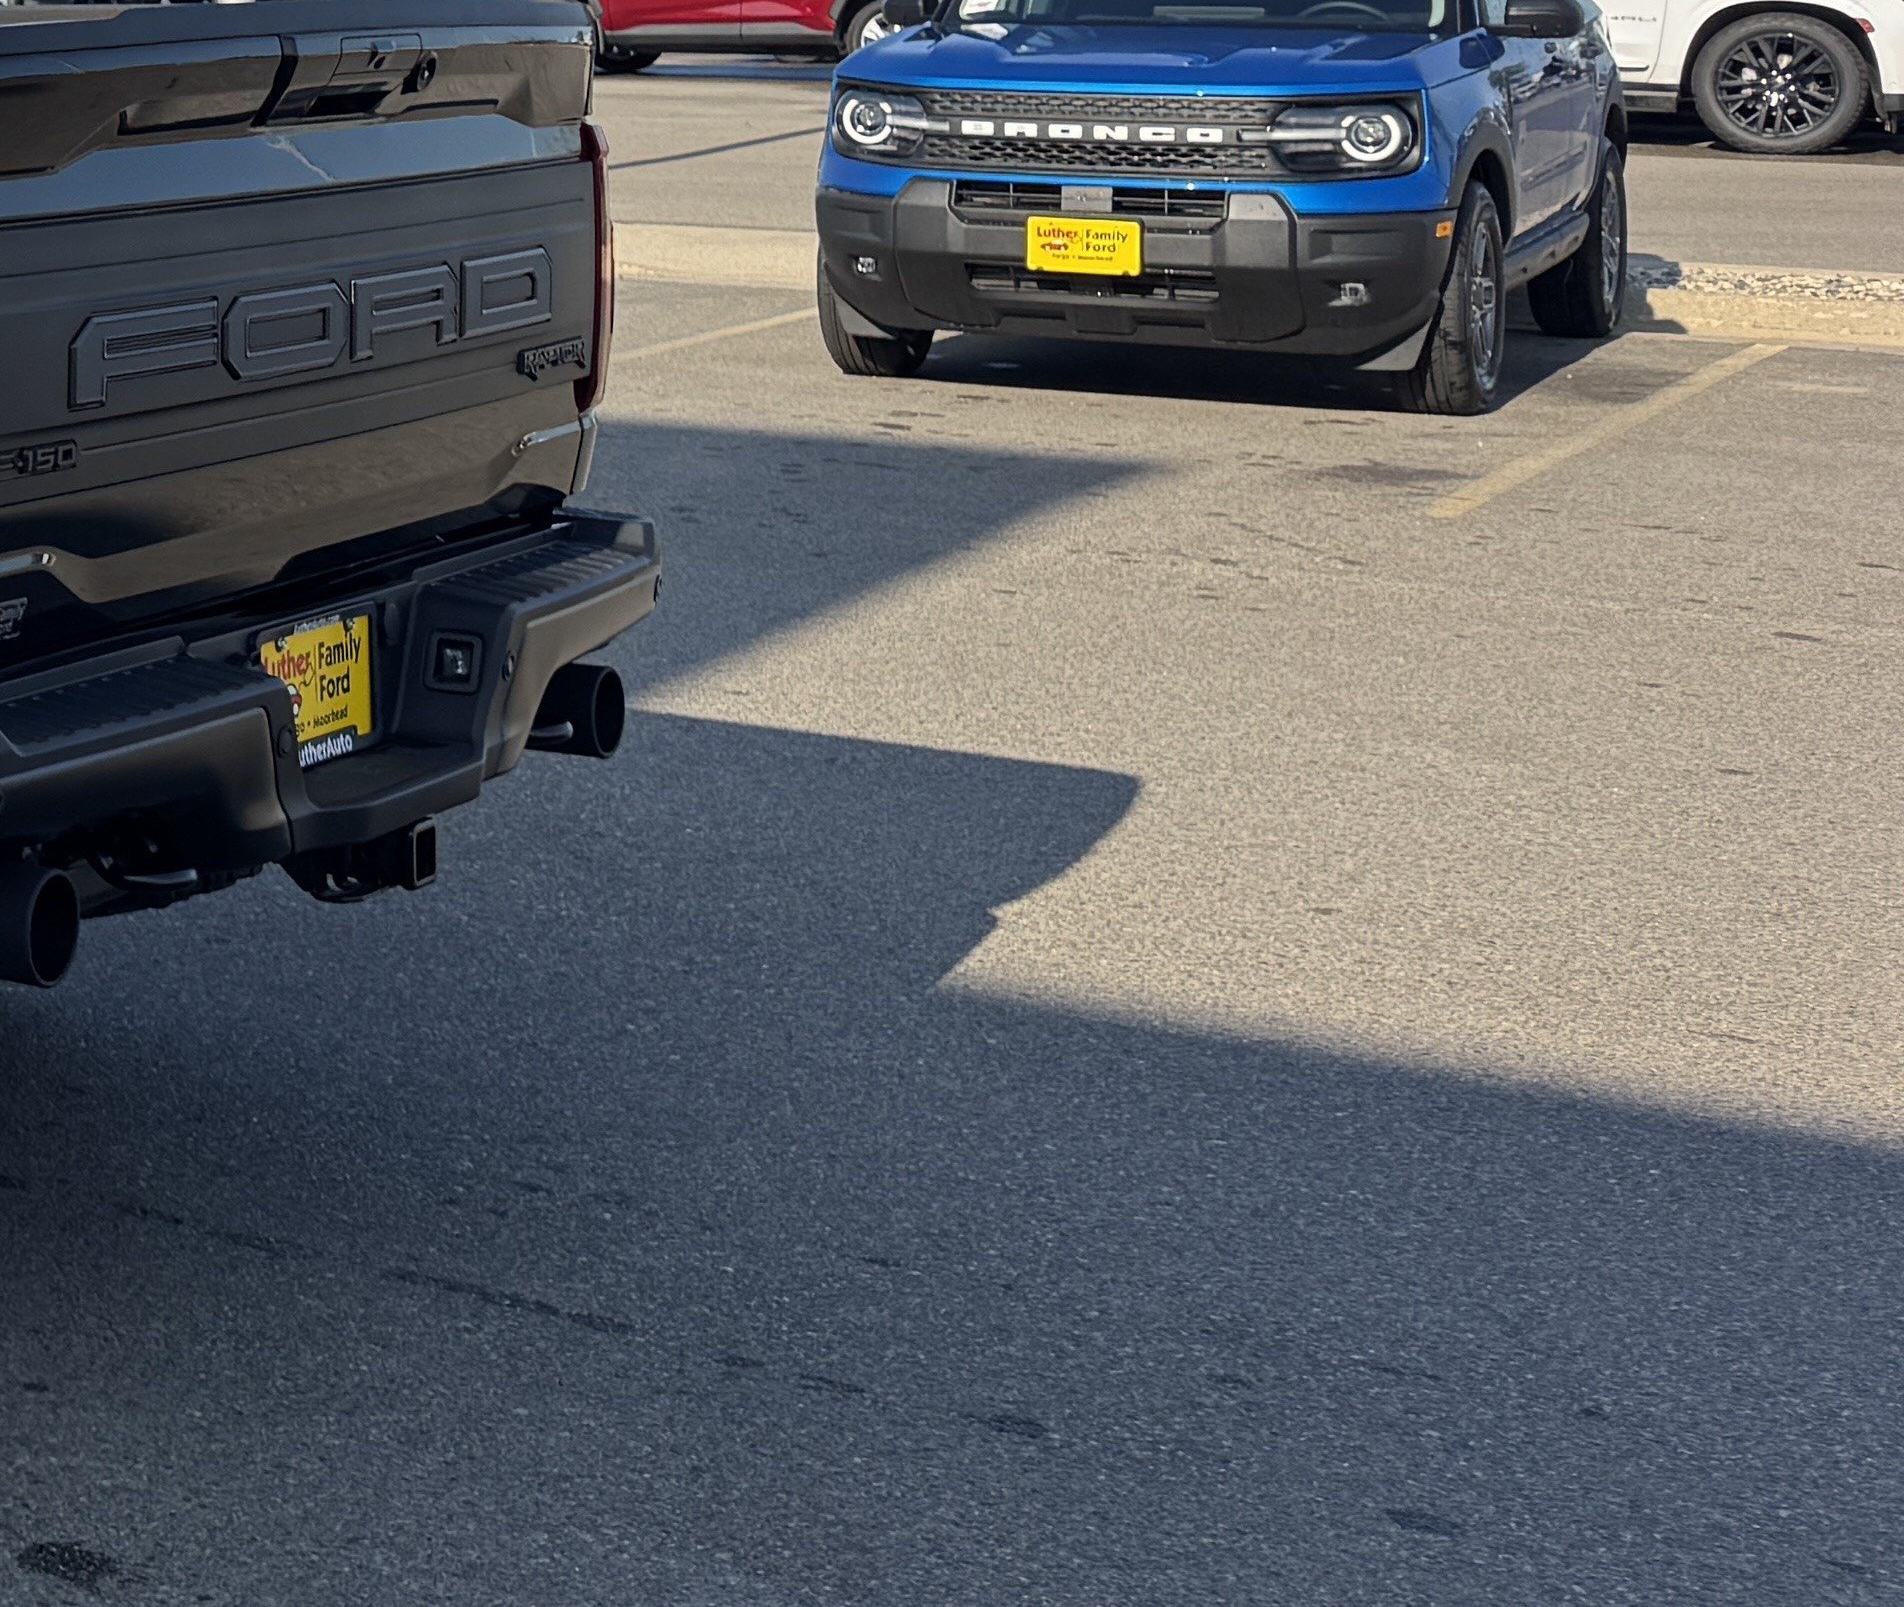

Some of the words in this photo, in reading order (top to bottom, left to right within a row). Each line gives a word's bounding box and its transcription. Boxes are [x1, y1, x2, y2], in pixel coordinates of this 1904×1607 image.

[960, 119, 1224, 143] BRONCO
[1036, 226, 1079, 238] Luther
[1085, 228, 1129, 243] Family
[1085, 242, 1117, 253] Ford
[67, 244, 553, 411] FORD
[318, 632, 362, 670] Family
[319, 665, 351, 703] Ford
[298, 732, 354, 768] utherAuto
